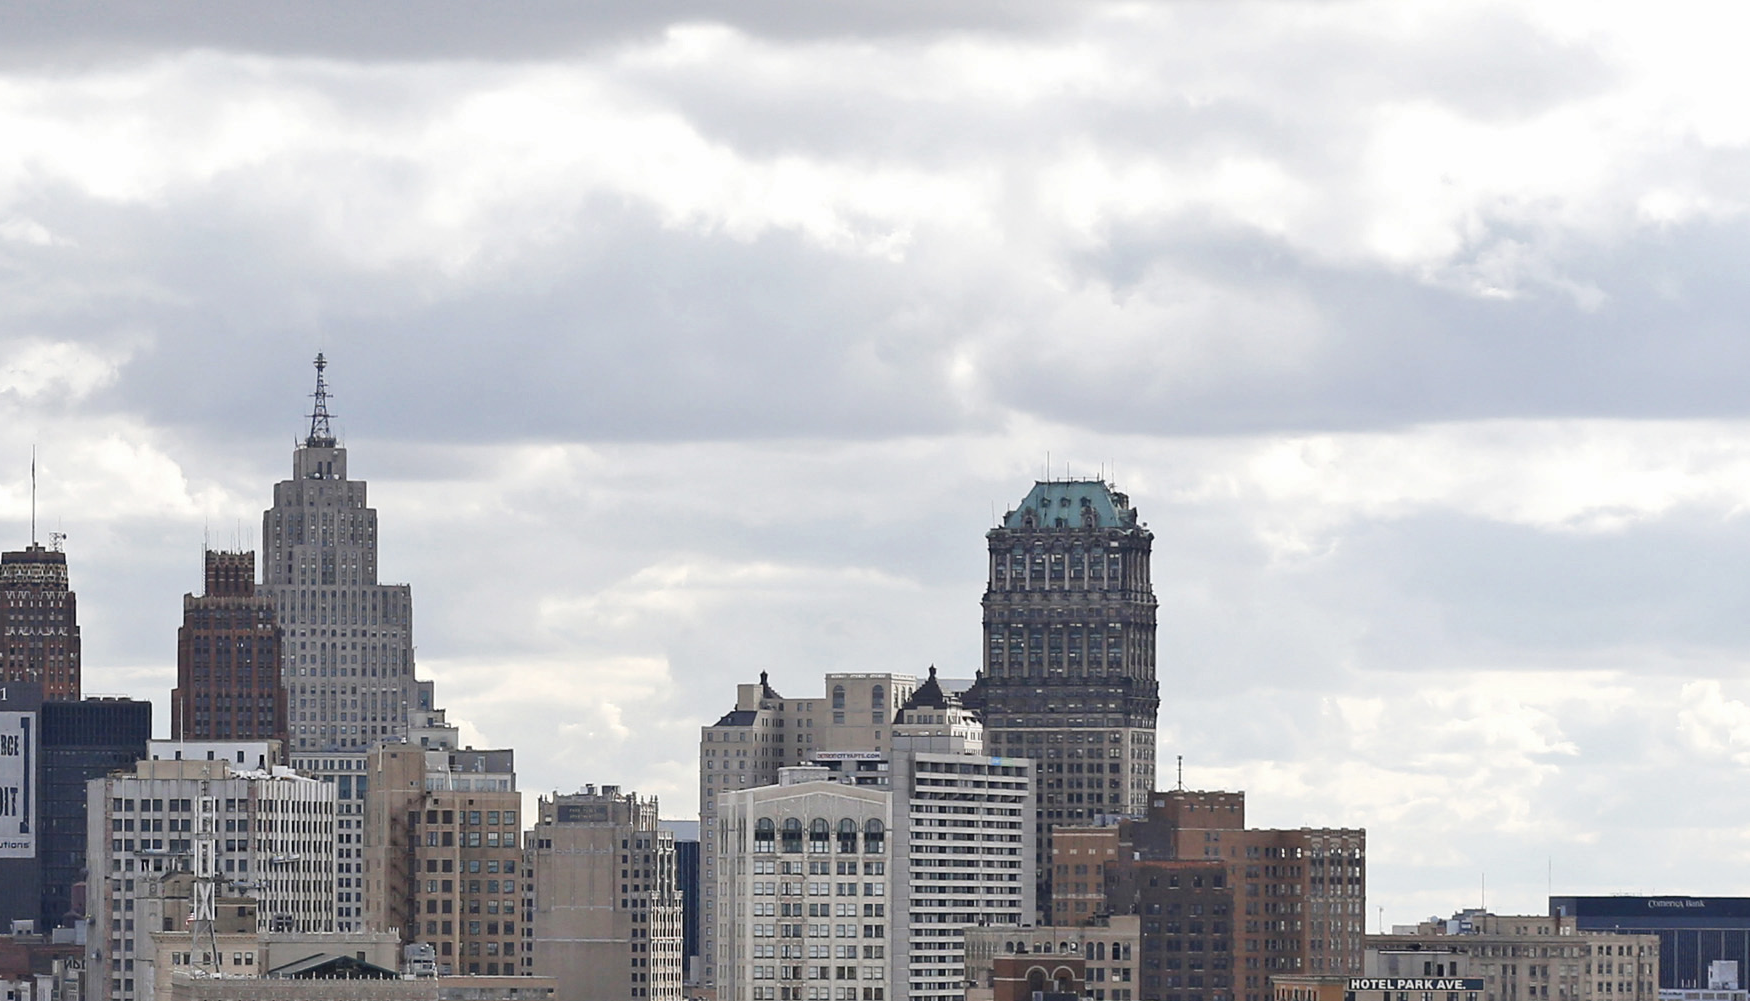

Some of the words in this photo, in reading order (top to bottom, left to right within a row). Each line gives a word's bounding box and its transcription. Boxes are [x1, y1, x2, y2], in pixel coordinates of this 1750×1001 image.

[1351, 979, 1394, 990] HOTEL
[1397, 979, 1433, 990] PARK
[1436, 979, 1466, 990] AVE.
